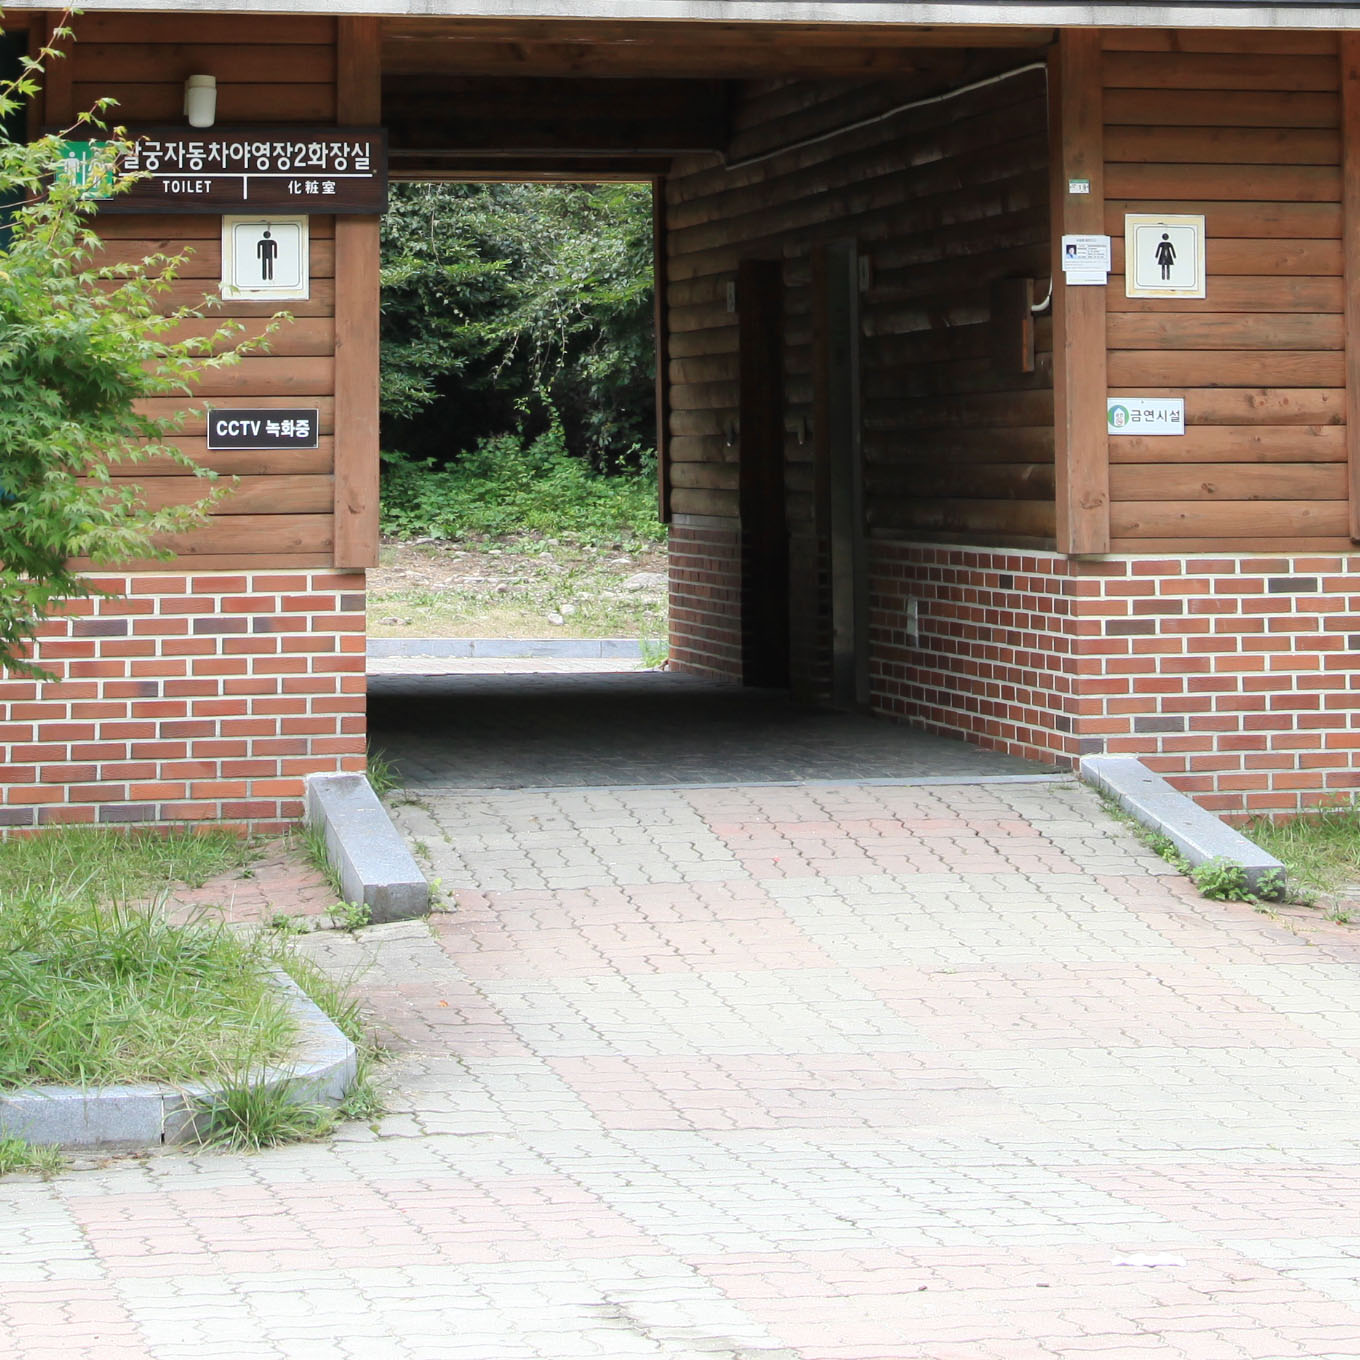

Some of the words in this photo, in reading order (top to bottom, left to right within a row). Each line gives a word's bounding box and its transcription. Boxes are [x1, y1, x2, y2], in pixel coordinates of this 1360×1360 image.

[162, 180, 212, 193] TOILET
[1130, 409, 1181, 423] 금연시설
[216, 420, 261, 437] CCTV
[265, 419, 311, 438] 녹화중
